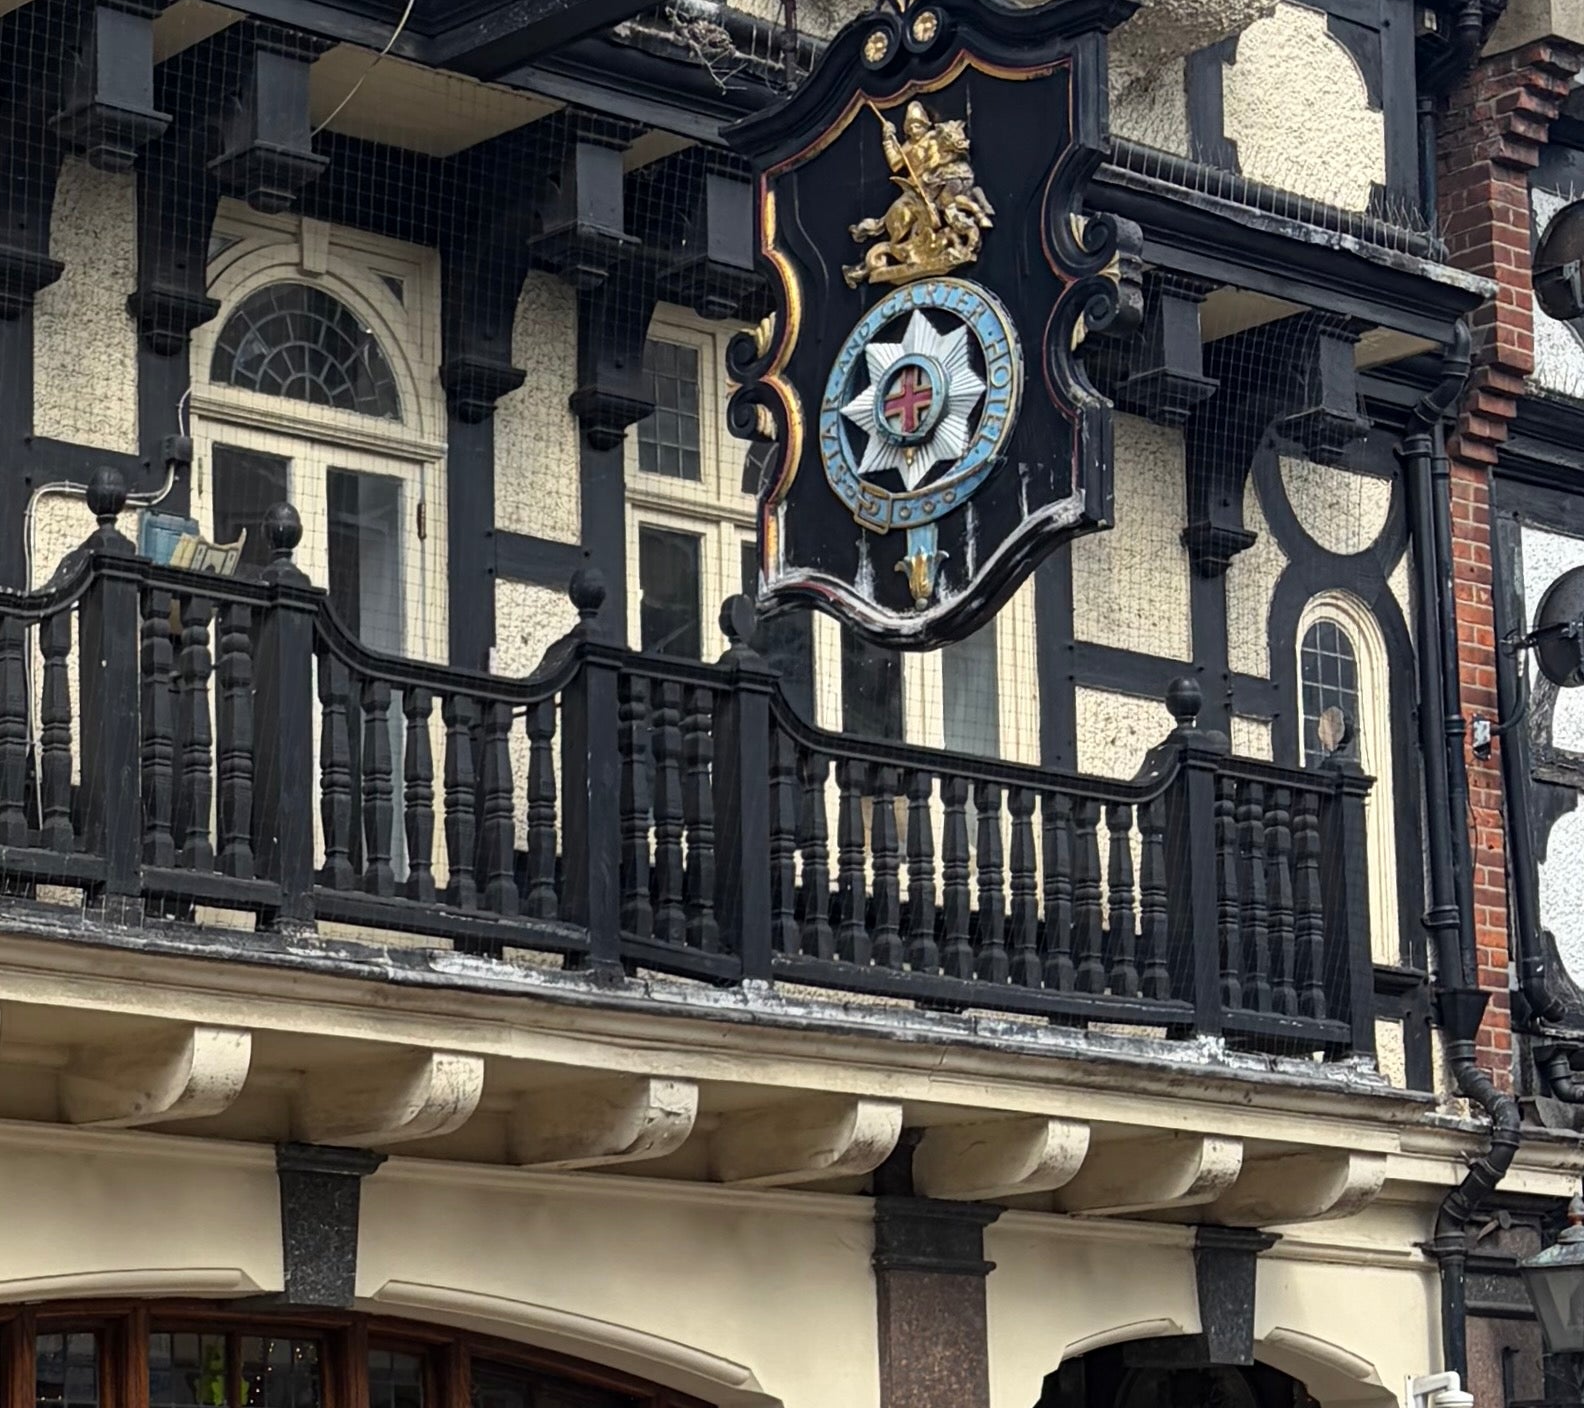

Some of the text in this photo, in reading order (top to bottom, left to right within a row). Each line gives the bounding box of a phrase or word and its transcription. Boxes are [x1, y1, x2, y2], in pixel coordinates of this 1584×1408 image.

[821, 282, 1012, 485] STAR AND GARTER HOTEL
